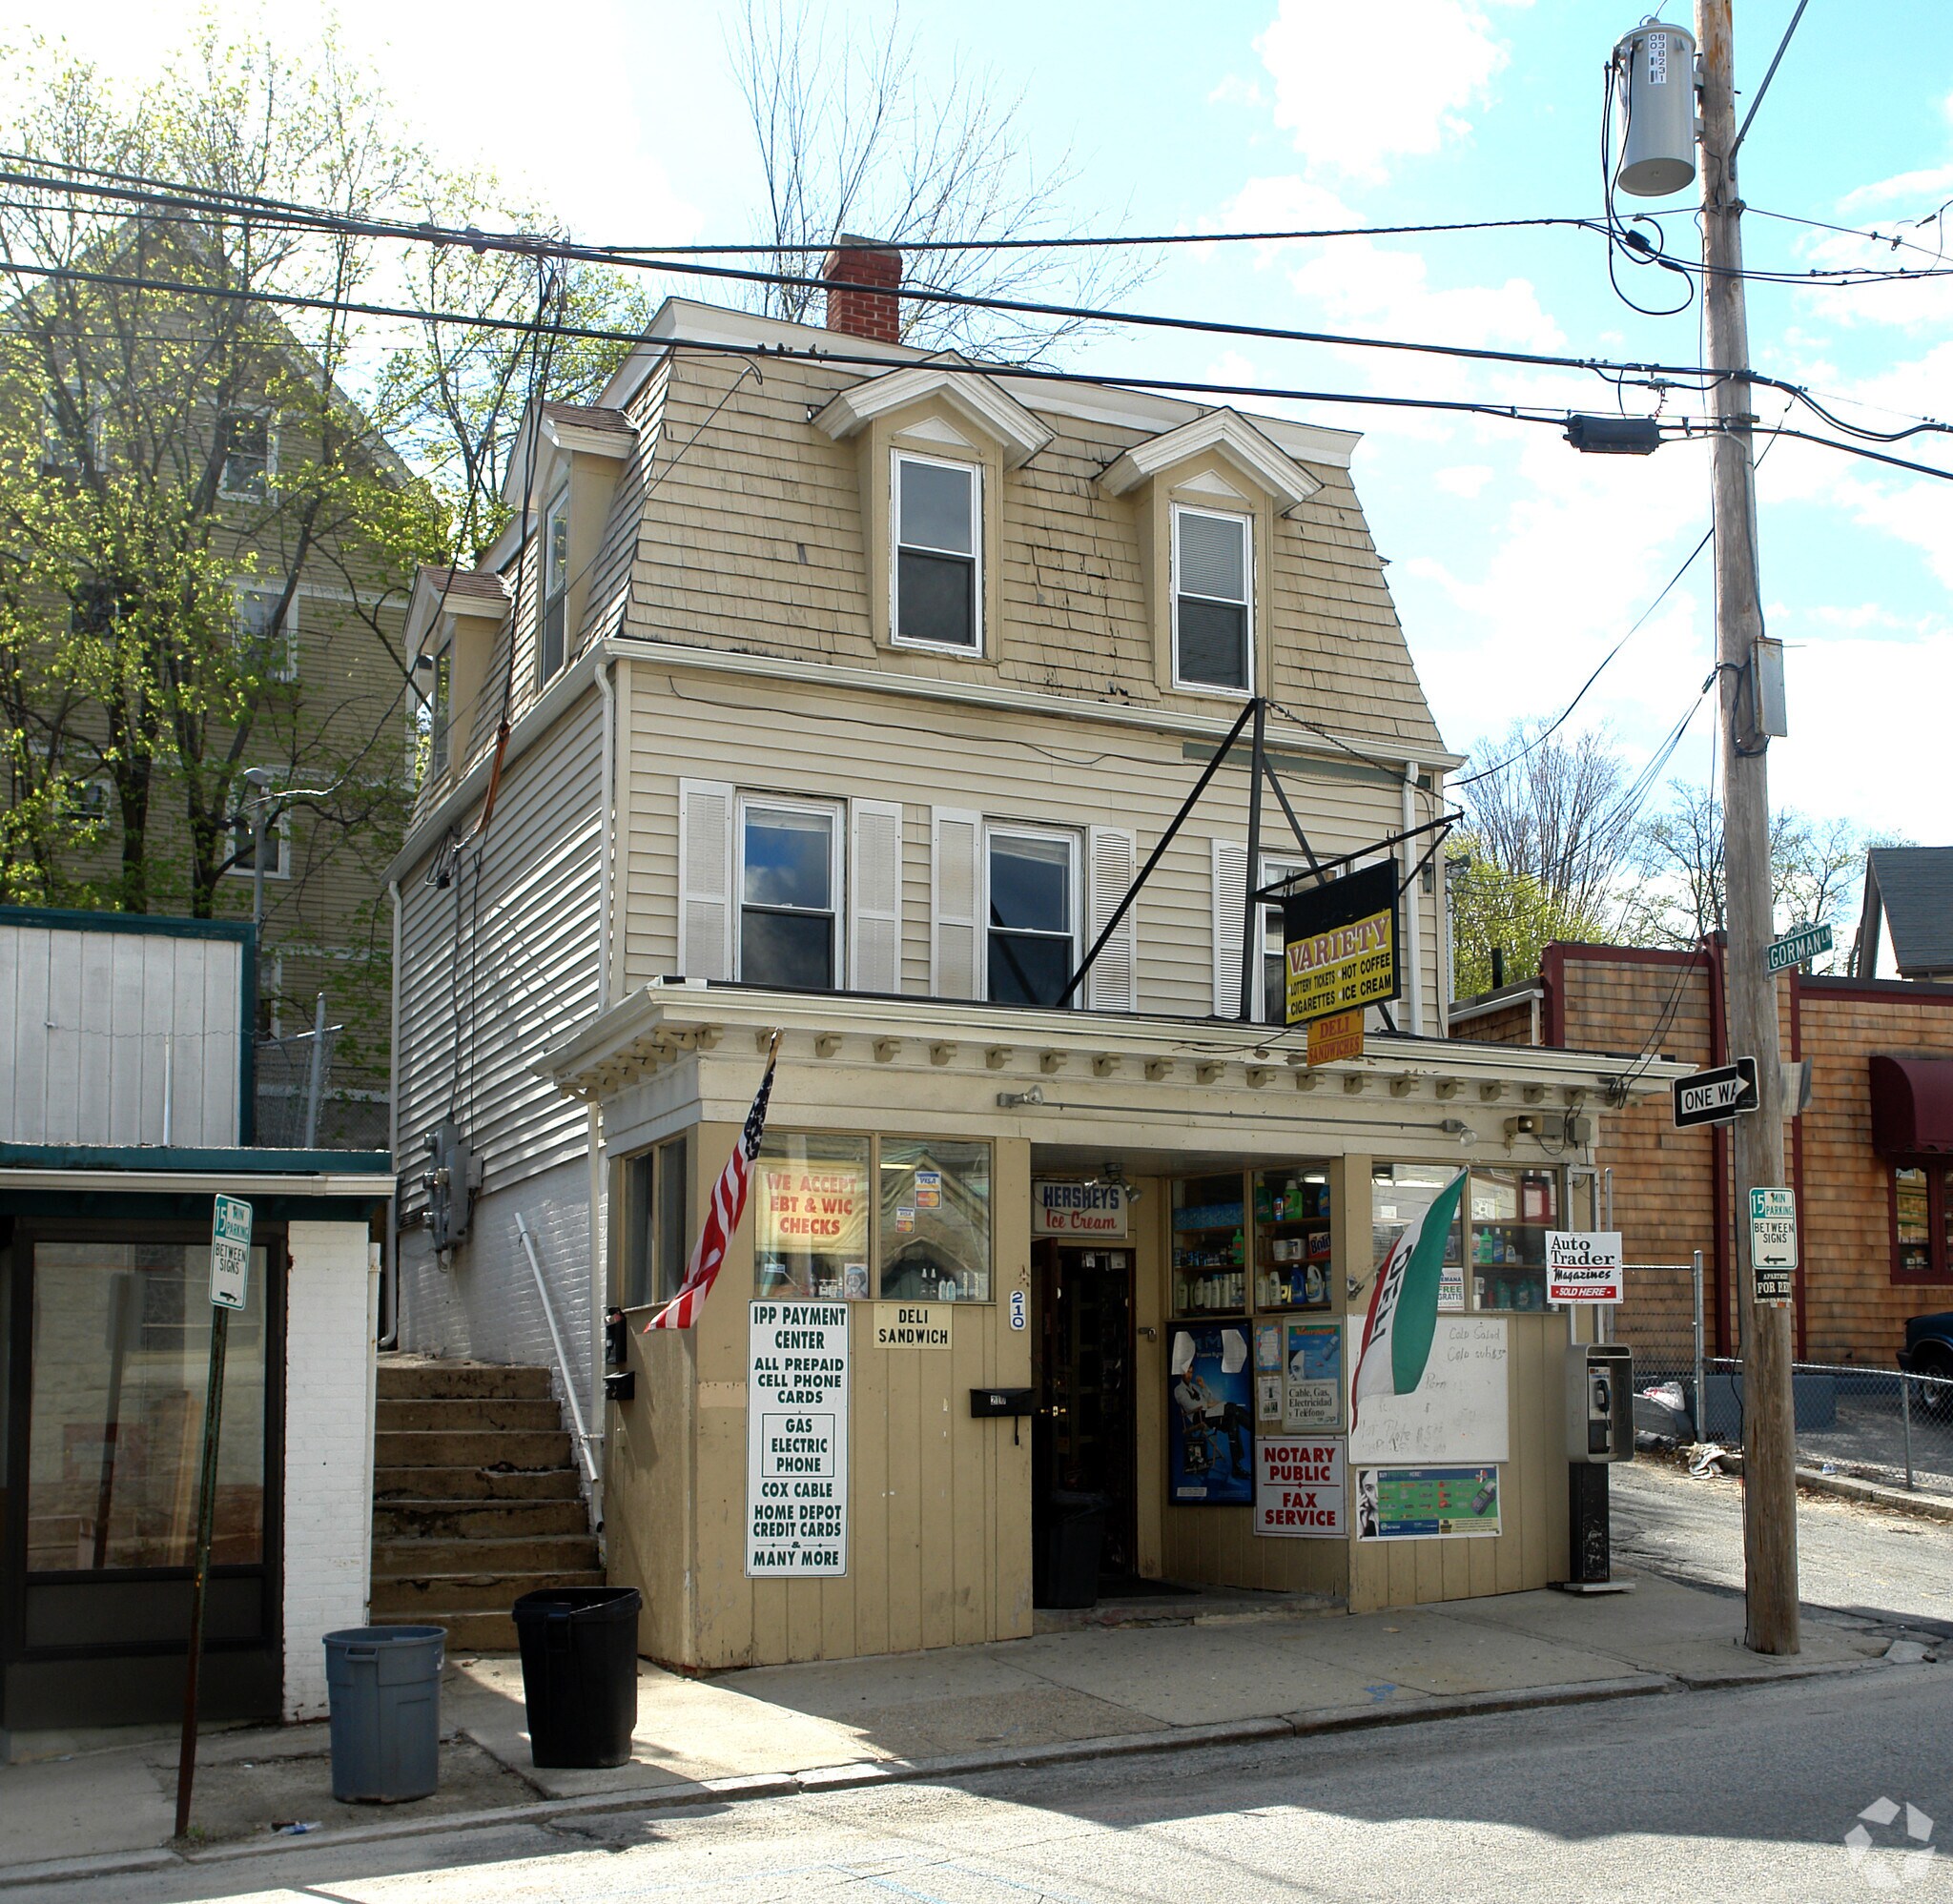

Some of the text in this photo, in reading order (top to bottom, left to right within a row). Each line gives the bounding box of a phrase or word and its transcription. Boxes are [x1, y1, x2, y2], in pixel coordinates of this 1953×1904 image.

[1287, 916, 1389, 976] VARIETY
[1771, 932, 1821, 968] GORMAN
[1820, 929, 1831, 944] LN
[1342, 952, 1390, 981] HOT COFFEE
[1290, 971, 1335, 996] LOTTERY TICKETS
[1342, 973, 1391, 1001] ICE CREAM
[1290, 991, 1335, 1016] CIGARETTES
[1320, 1016, 1349, 1039] DELI
[1308, 1035, 1360, 1063] SANDWICHES
[1685, 1081, 1736, 1111] ONE WA
[766, 1174, 857, 1195] WE ACCEPT
[770, 1196, 853, 1216] EBT & WIC
[1752, 1194, 1765, 1215] 15
[1771, 1193, 1786, 1204] MIN
[216, 1205, 227, 1233] 15
[1046, 1208, 1118, 1230] Ice Cream
[1766, 1205, 1793, 1217] PARKING
[226, 1221, 248, 1239] PARKING
[779, 1217, 841, 1236] CHECKS
[1755, 1222, 1794, 1233] BETWEEN
[1551, 1235, 1591, 1251] Auto
[1762, 1233, 1787, 1244] SIGNS
[215, 1242, 246, 1262] BETWEEN
[1551, 1250, 1615, 1265] Trader
[219, 1258, 239, 1275] SIGNS
[1552, 1267, 1612, 1283] Magazines
[1558, 1287, 1607, 1296] SOLD HERE
[1757, 1281, 1776, 1294] FOR
[753, 1306, 846, 1326] IPP PAYMENT
[898, 1309, 929, 1324] DELI
[1012, 1292, 1025, 1328] 210
[774, 1330, 825, 1349] CENTER
[878, 1328, 948, 1344] SANDWICH
[754, 1358, 844, 1371] ALL PREPAID
[758, 1374, 841, 1388] CELL PHONE
[777, 1390, 823, 1403] CARDS
[1288, 1397, 1332, 1408] Electricidad
[785, 1418, 812, 1433] GAS
[771, 1438, 828, 1453] ELECTRIC
[1264, 1447, 1336, 1463] NOTARY
[776, 1457, 821, 1472] PHONE
[1269, 1465, 1331, 1481] PUBLIC
[762, 1483, 833, 1498] COX CABLE
[1283, 1492, 1318, 1508] FAX
[754, 1505, 842, 1520] HOME DEPOT
[1264, 1509, 1337, 1526] SERVICE
[753, 1522, 841, 1537] CREDIT CARDS
[753, 1551, 839, 1566] MANY MORE
